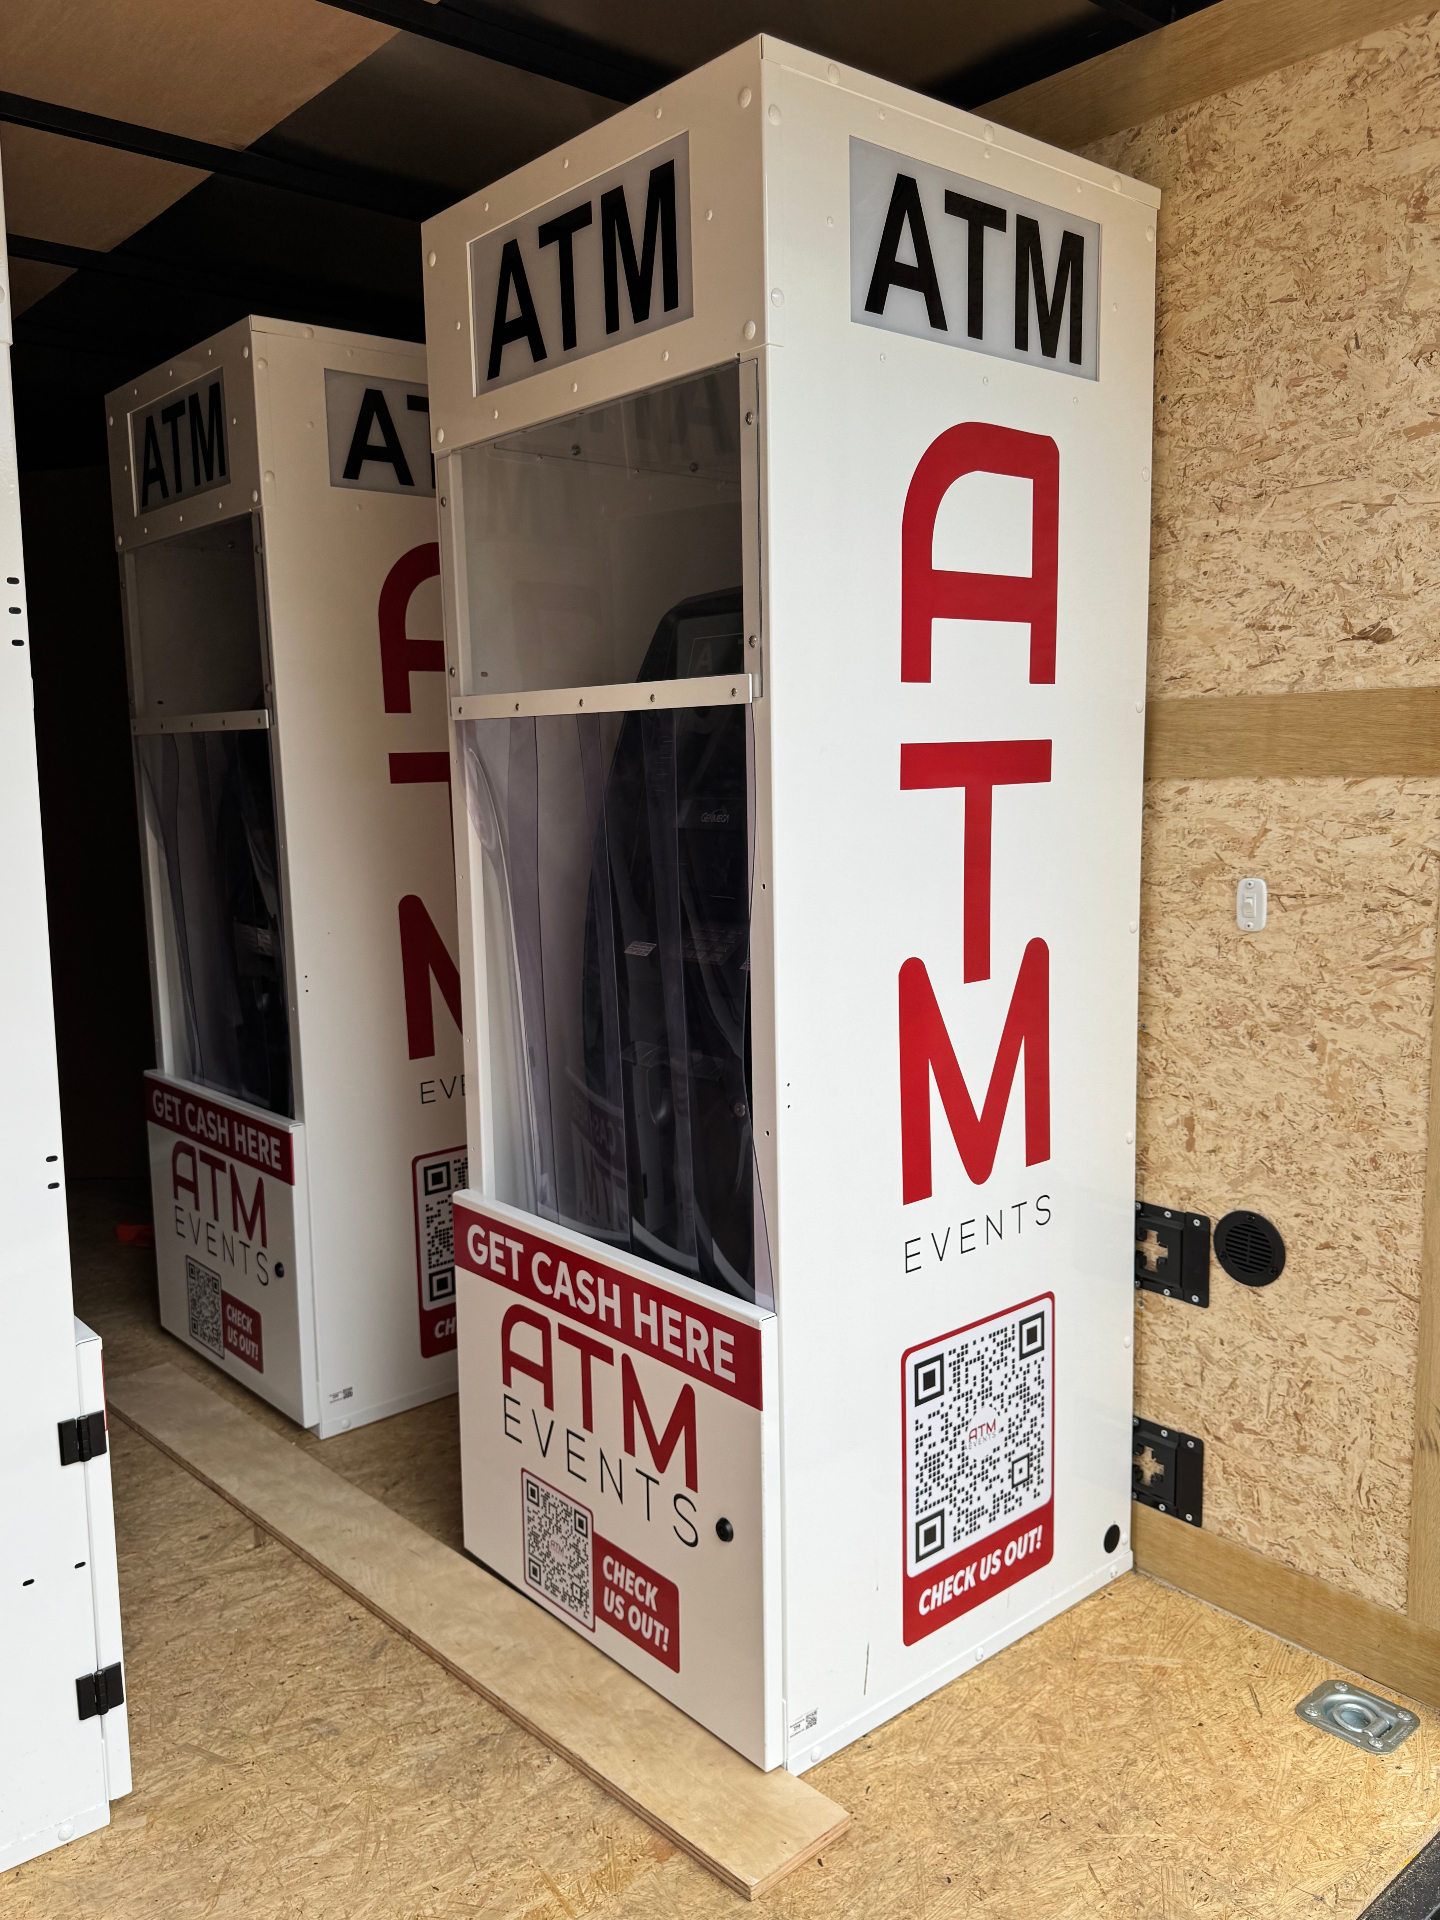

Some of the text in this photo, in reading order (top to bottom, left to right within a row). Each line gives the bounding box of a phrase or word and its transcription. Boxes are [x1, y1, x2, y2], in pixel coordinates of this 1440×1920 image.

[486, 158, 679, 381] ATM
[864, 173, 1085, 366] ATM
[141, 381, 227, 506] ATM
[152, 1088, 282, 1171] GET CASH HERE
[172, 1140, 267, 1249] ATM
[904, 1195, 1052, 1274] EVENTS
[175, 1204, 269, 1287] EVENTS
[226, 1303, 253, 1333] CHECK
[227, 1325, 259, 1361] US OUT!
[467, 1224, 736, 1383] GET CASH HERE
[501, 1304, 699, 1494] ATM
[969, 1418, 996, 1442] ATM
[503, 1393, 699, 1548] EVENTS
[969, 1432, 996, 1450] EVENTS
[603, 1555, 659, 1613] CHECK
[918, 1525, 1043, 1616] CHECK US OUT!
[603, 1587, 670, 1653] US OUT!
